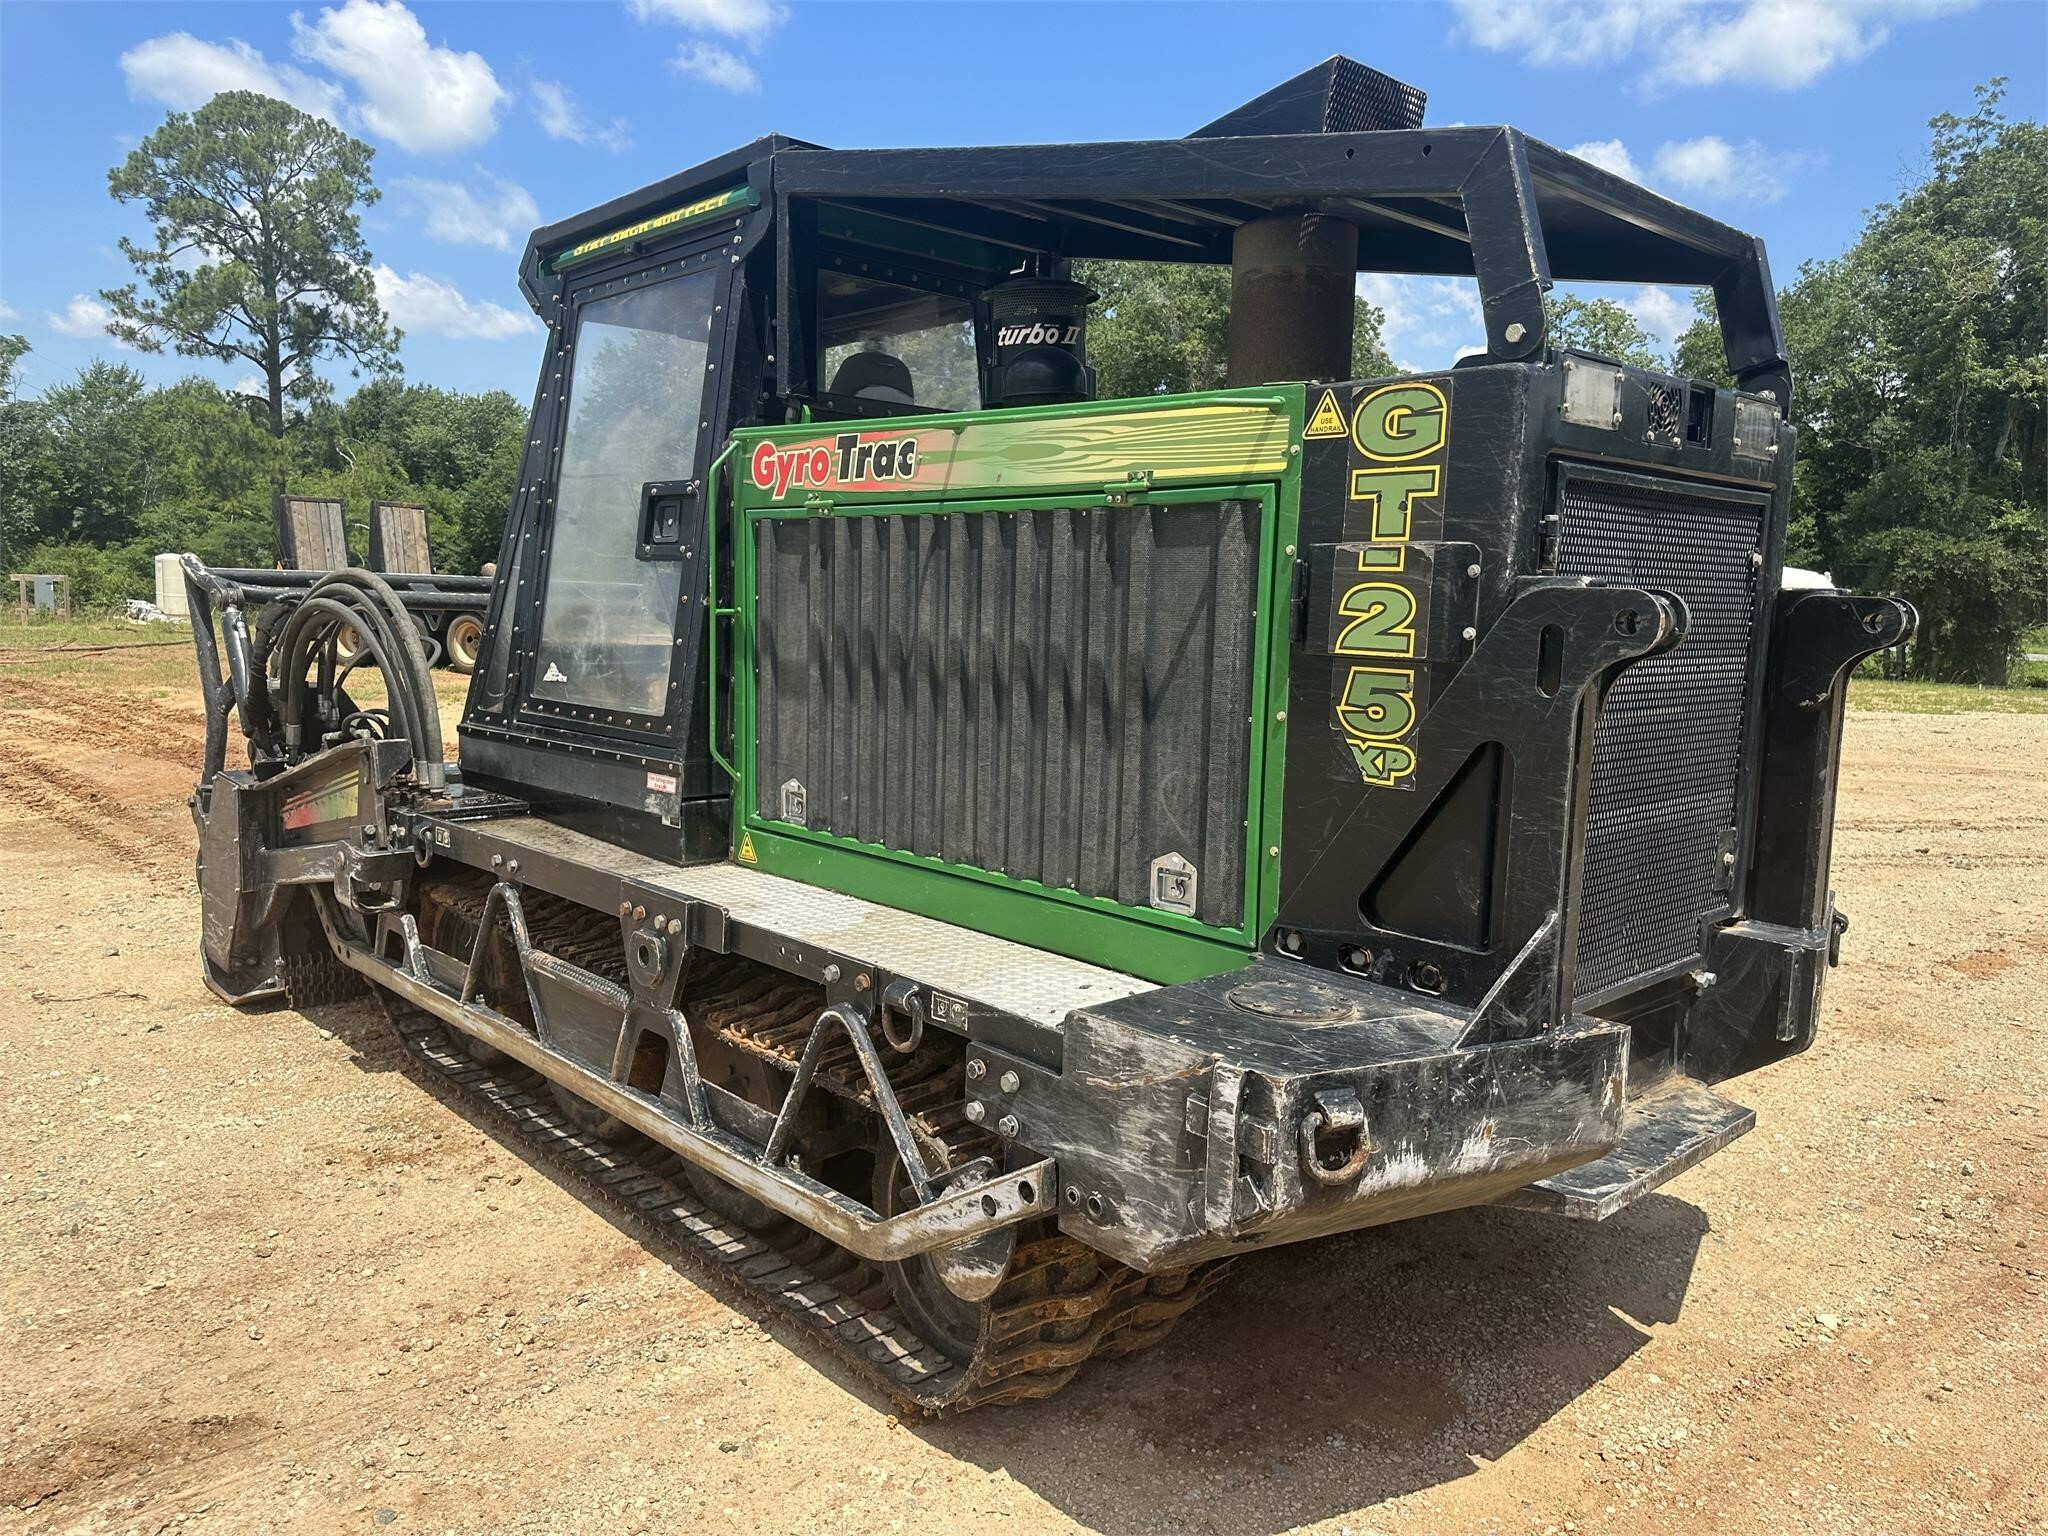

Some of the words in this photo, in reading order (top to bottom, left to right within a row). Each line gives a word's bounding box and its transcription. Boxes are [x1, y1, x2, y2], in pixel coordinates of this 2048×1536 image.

[997, 322, 1060, 346] turbo
[1320, 417, 1334, 425] USE
[1310, 425, 1343, 433] HANDRAIL
